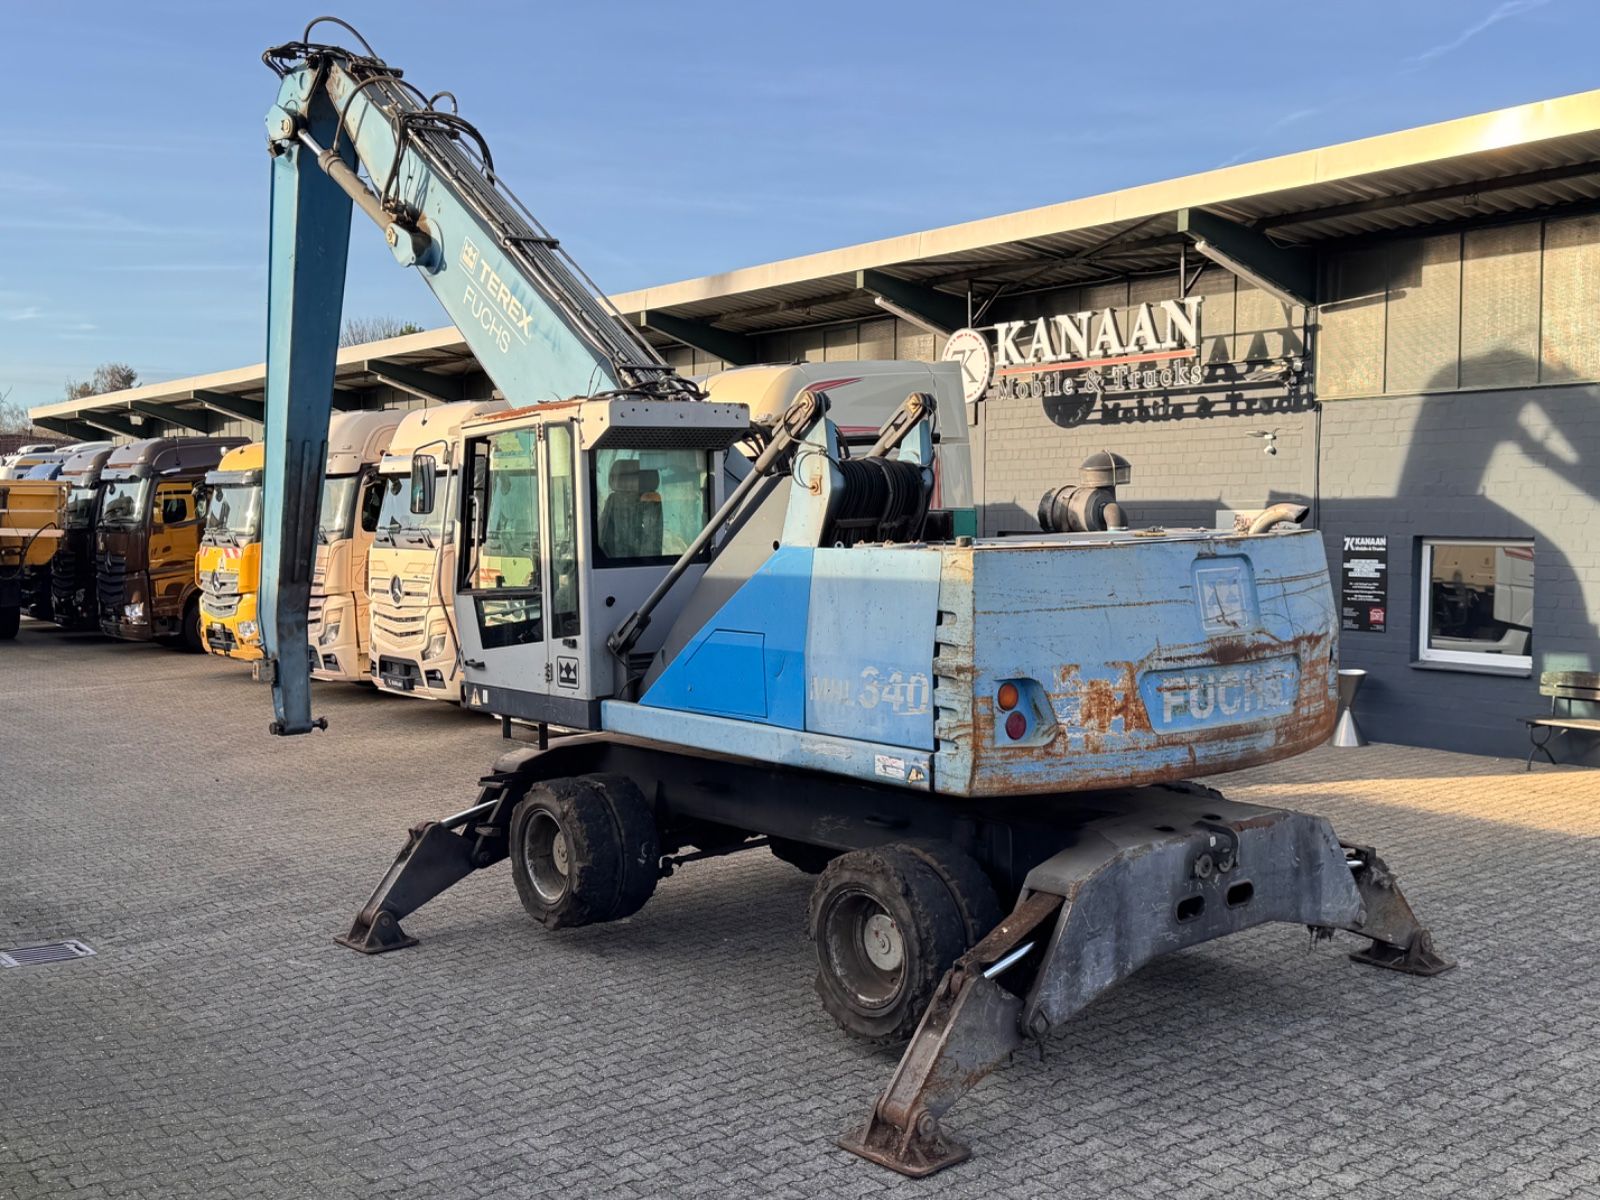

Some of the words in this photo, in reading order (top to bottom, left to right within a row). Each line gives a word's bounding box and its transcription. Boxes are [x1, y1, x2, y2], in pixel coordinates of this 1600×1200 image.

[463, 284, 512, 355] FUCHS
[478, 258, 534, 338] TEREX
[993, 296, 1203, 367] KANAAN
[996, 370, 1074, 401] Mobile
[1085, 370, 1105, 393] &
[1112, 359, 1202, 391] Trucks
[858, 665, 930, 714] 340
